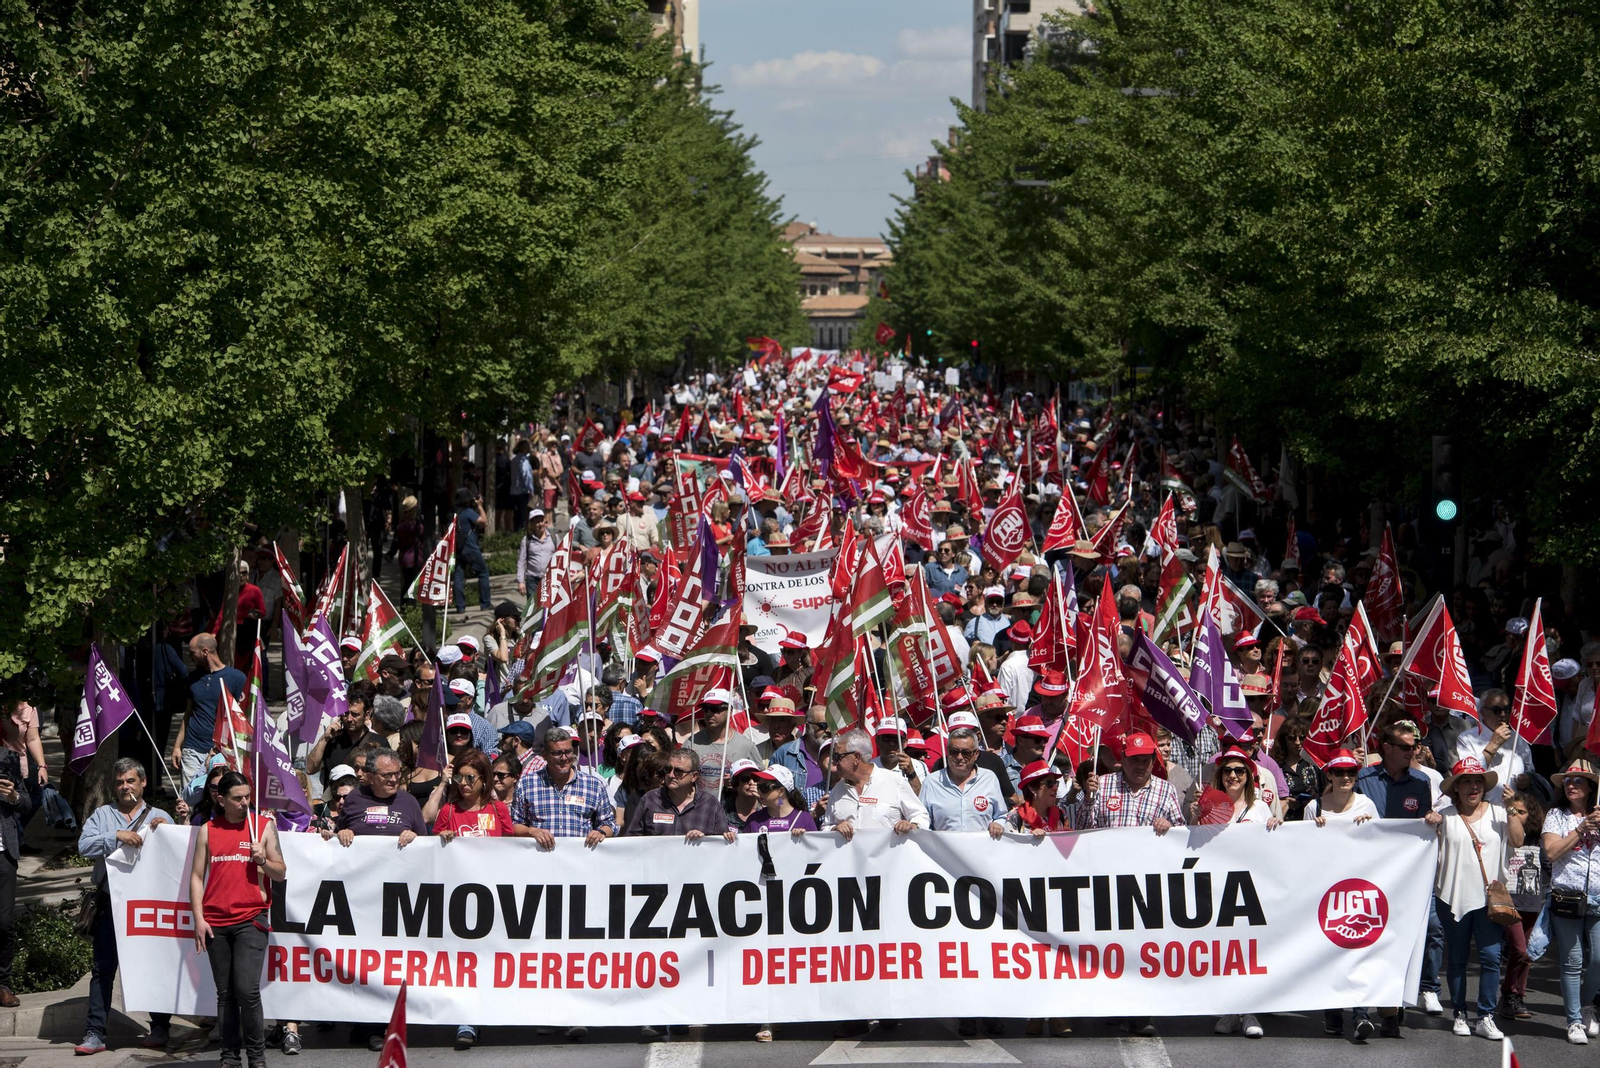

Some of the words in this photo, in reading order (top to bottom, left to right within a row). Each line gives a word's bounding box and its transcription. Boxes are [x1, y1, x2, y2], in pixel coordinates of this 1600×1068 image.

[765, 560, 790, 575] NO
[795, 559, 816, 572] AL
[787, 578, 803, 588] DE
[804, 575, 825, 587] LOS
[903, 635, 928, 689] Granada
[270, 879, 357, 937] LA
[381, 863, 882, 940] MOVILIZACIÓN
[907, 857, 1268, 933] CONTINÚA
[1327, 889, 1380, 919] UGT
[133, 907, 196, 930] CCO
[267, 944, 478, 988] RECUPERAR
[493, 950, 681, 989] DERECHOS
[742, 942, 923, 986] DEFENDER
[938, 941, 979, 979] EL
[990, 942, 1125, 980] ESTADO
[1139, 938, 1268, 979] SOCIAL
